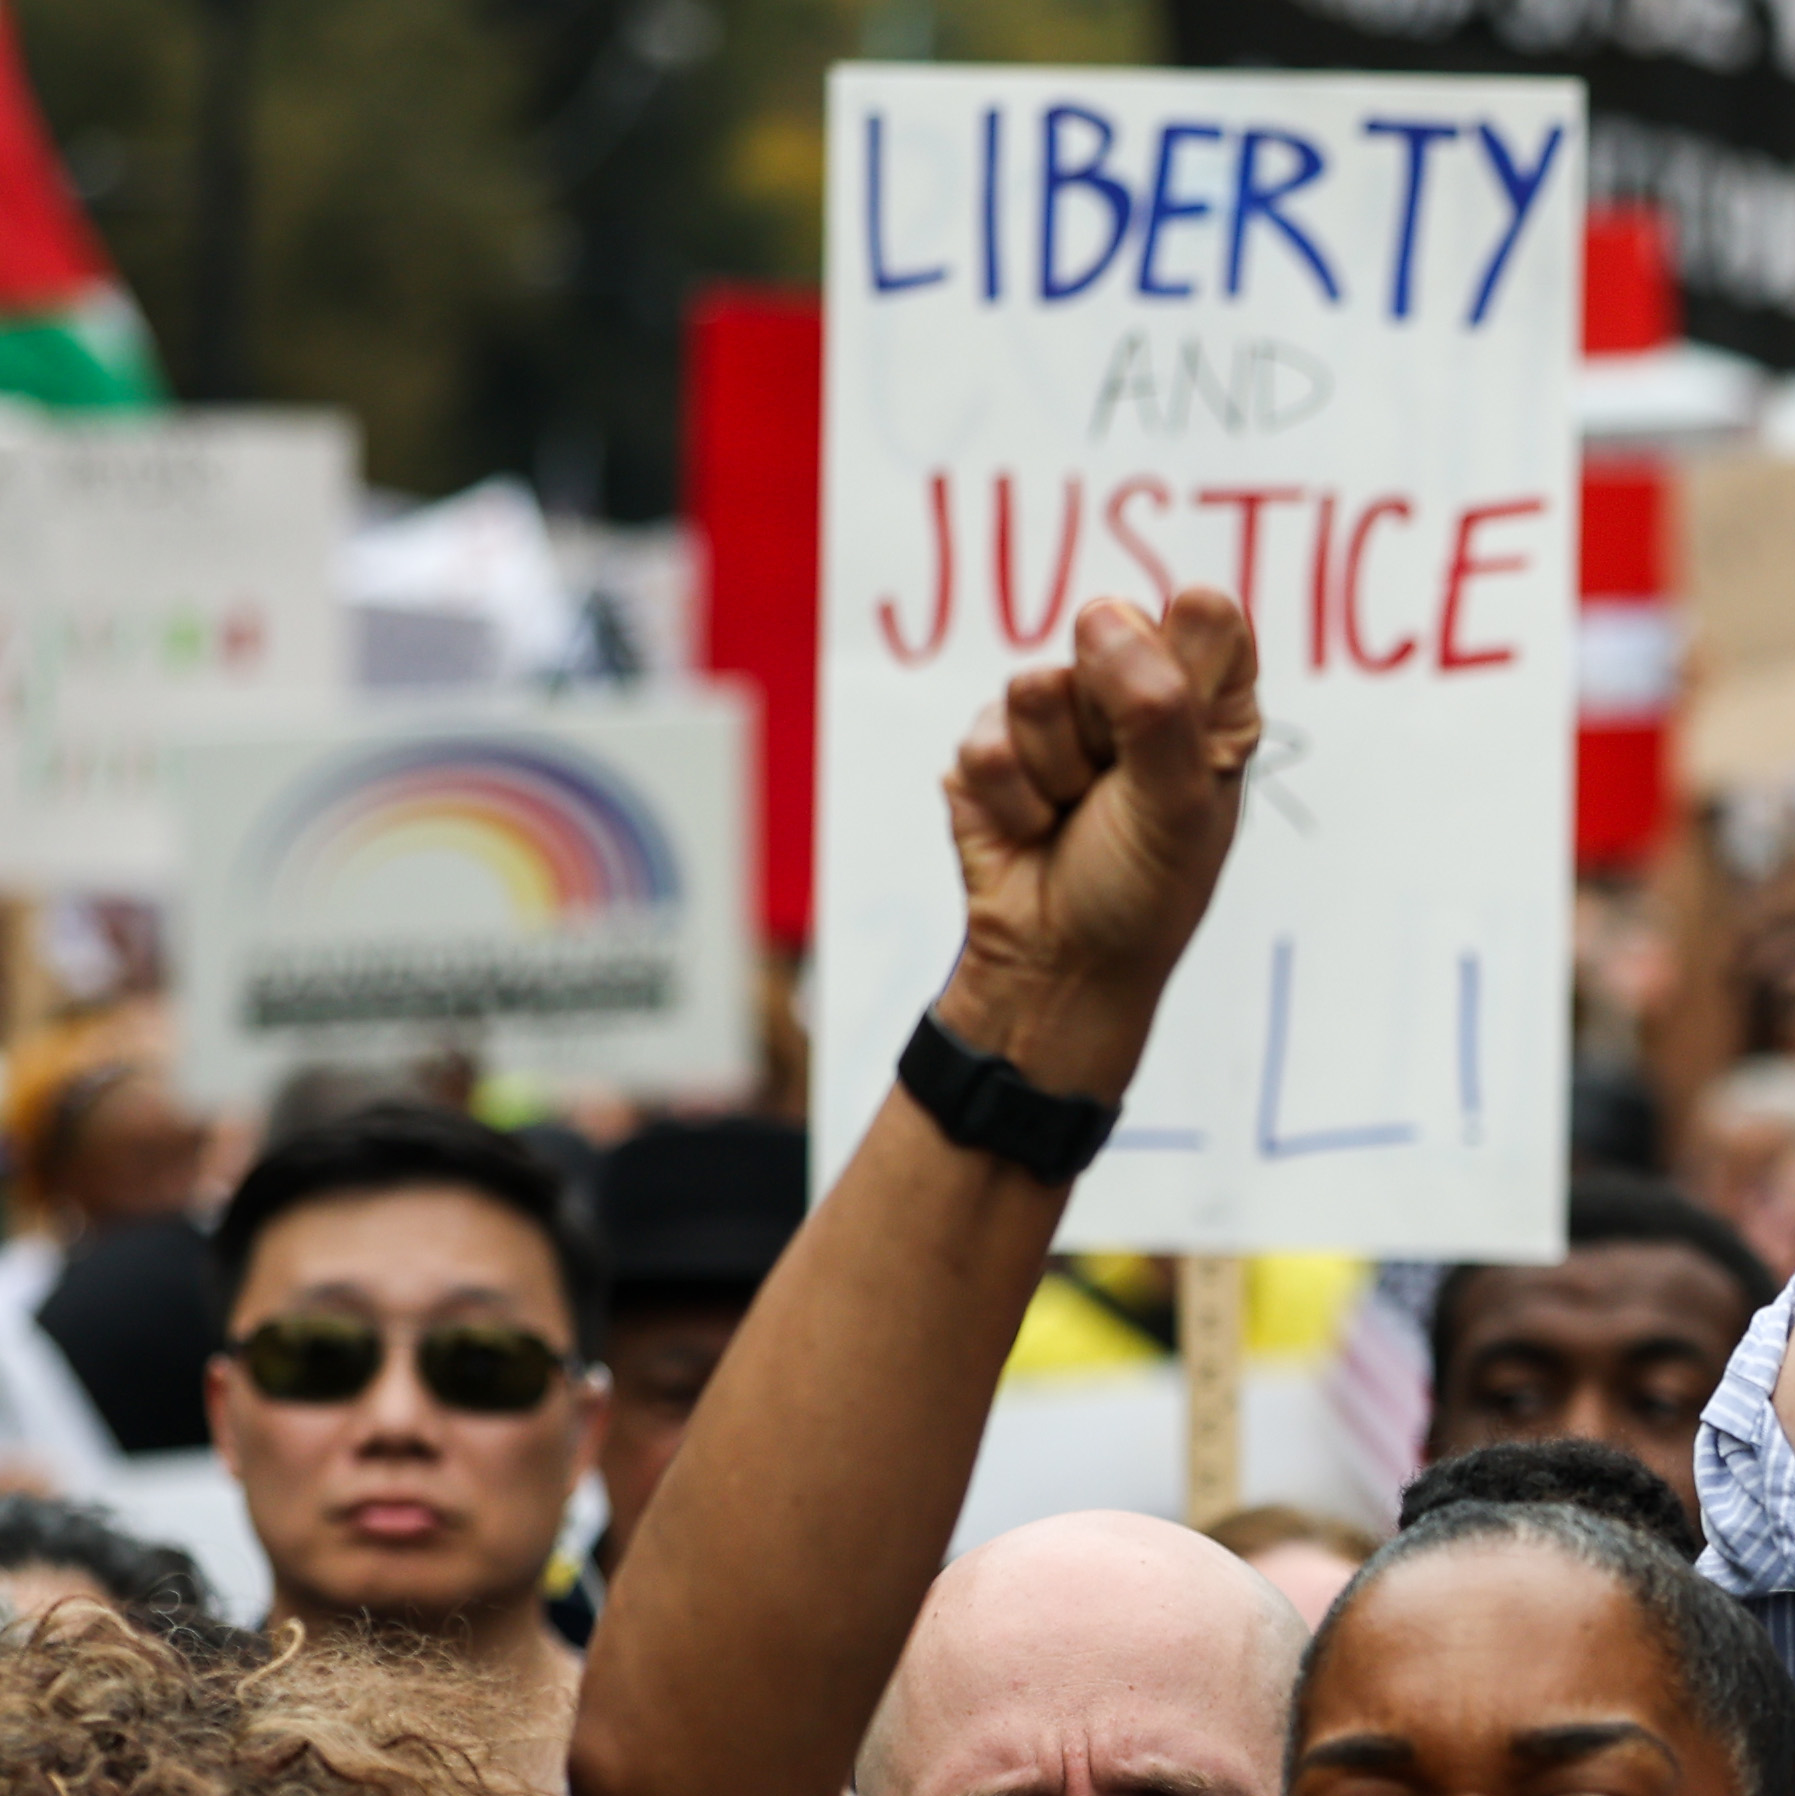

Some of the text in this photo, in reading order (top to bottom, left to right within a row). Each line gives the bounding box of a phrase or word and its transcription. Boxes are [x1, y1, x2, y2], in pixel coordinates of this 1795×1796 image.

[862, 100, 1567, 330] LIBERTY
[1083, 325, 1338, 448] AND
[874, 466, 1550, 678] JUSTICE
